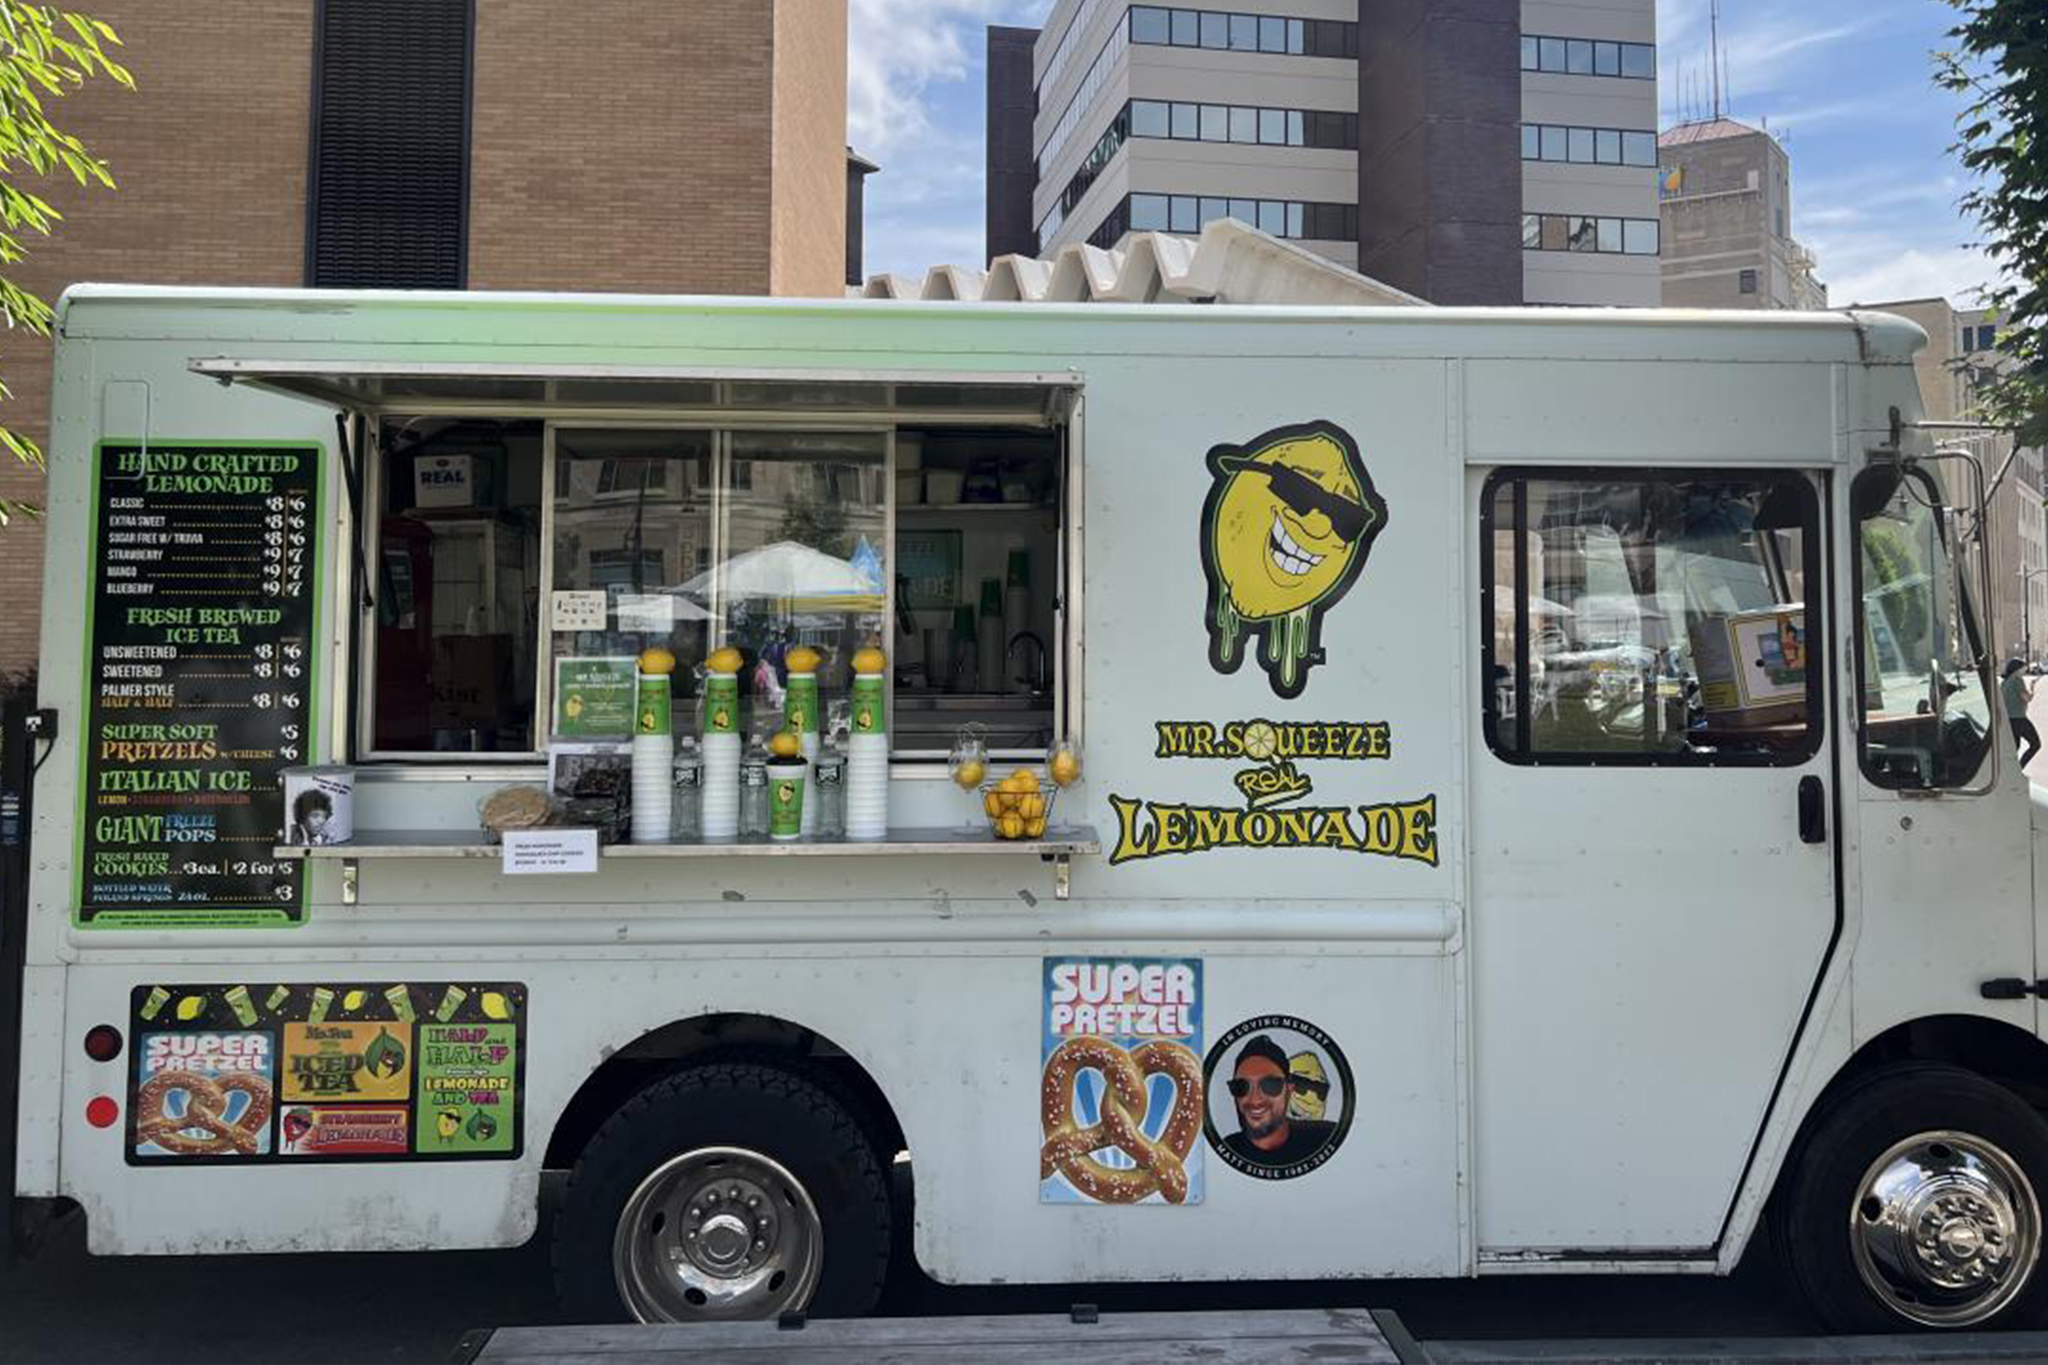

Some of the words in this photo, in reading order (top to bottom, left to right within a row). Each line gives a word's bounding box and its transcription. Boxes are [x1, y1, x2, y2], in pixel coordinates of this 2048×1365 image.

[117, 453, 187, 473] HAND
[193, 455, 299, 476] CRAFTED
[146, 475, 273, 494] LEMONADE
[421, 471, 464, 484] REAL
[110, 498, 145, 509] CLASSIC
[266, 496, 284, 512] $8
[289, 496, 306, 512] $6
[109, 516, 137, 527] EXTRA
[138, 516, 166, 527] SWEET
[265, 514, 283, 529] $8
[288, 514, 305, 529] $6
[108, 533, 136, 544] SUGAR
[137, 533, 157, 544] FREE
[264, 531, 283, 546] $8
[288, 532, 306, 546] $6
[107, 550, 163, 561] STRAWBERRY
[263, 547, 281, 561] $9
[288, 548, 303, 563] $7
[107, 567, 137, 577] MANGO
[262, 564, 281, 578] $9
[287, 565, 303, 580] $7
[106, 583, 154, 594] BLUEBERRY
[262, 581, 280, 596] $9
[287, 581, 303, 597] $7
[127, 608, 193, 627] FRESH
[199, 608, 281, 627] BREWED
[166, 628, 199, 644] ICE
[203, 628, 241, 644] TEA
[103, 646, 177, 659] UNSWEETENED
[255, 644, 273, 659] $8
[283, 644, 301, 659] $6
[103, 665, 163, 678] SWEETENED
[253, 662, 272, 678] $8
[283, 663, 300, 678] $6
[102, 684, 144, 696] PALMER
[144, 684, 175, 696] STYLE
[252, 693, 271, 709] $8
[282, 693, 300, 709] $6
[101, 724, 167, 741] SUPER
[168, 724, 219, 740] SOFT
[281, 724, 298, 741] $5
[101, 741, 218, 762] PRETZELS
[280, 747, 298, 761] $6
[99, 769, 201, 792] ITALIAN
[209, 771, 251, 791] ICE
[95, 815, 164, 844] GIANT
[165, 829, 217, 842] POPS
[1108, 794, 1440, 868] LEMONADE
[94, 861, 168, 878] COOKIES
[250, 861, 276, 875] for
[275, 885, 293, 900] $3
[1051, 962, 1196, 1005] SUPER
[1051, 1003, 1195, 1036] PRETZEL
[1221, 1033, 1236, 1046] IN
[1236, 1018, 1280, 1036] LOVING
[1282, 1018, 1330, 1046] MEMORY
[146, 1035, 269, 1057] SUPER
[426, 1045, 510, 1066] HALF
[146, 1055, 269, 1073] PRETZEL
[290, 1054, 365, 1074] ICED
[298, 1073, 362, 1093] TEA
[424, 1076, 511, 1092] LEMONADE
[432, 1091, 467, 1105] AND
[1246, 1165, 1281, 1179] SINCE
